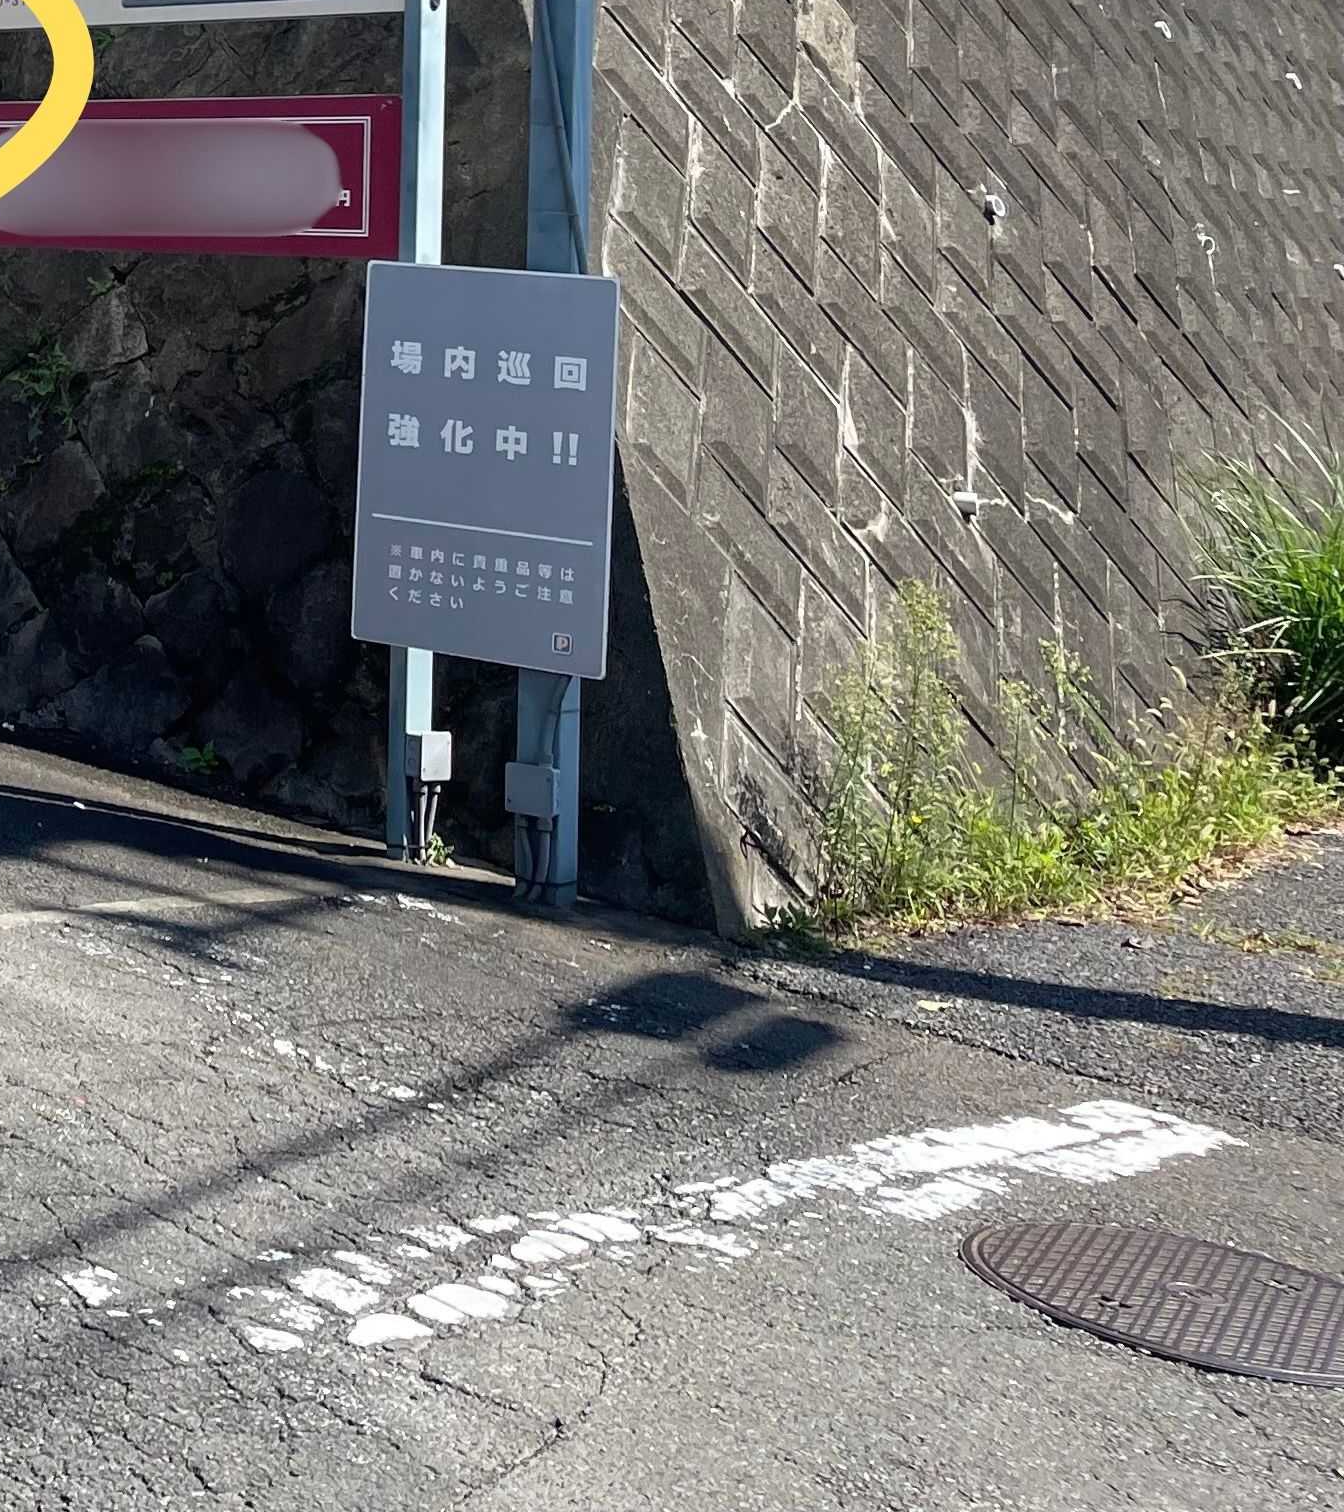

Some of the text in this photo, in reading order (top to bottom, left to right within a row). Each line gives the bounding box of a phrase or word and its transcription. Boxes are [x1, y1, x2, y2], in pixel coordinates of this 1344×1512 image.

[390, 340, 588, 392] 場内巡回
[387, 564, 575, 605] 置かないようご注意
[388, 586, 464, 609] ください
